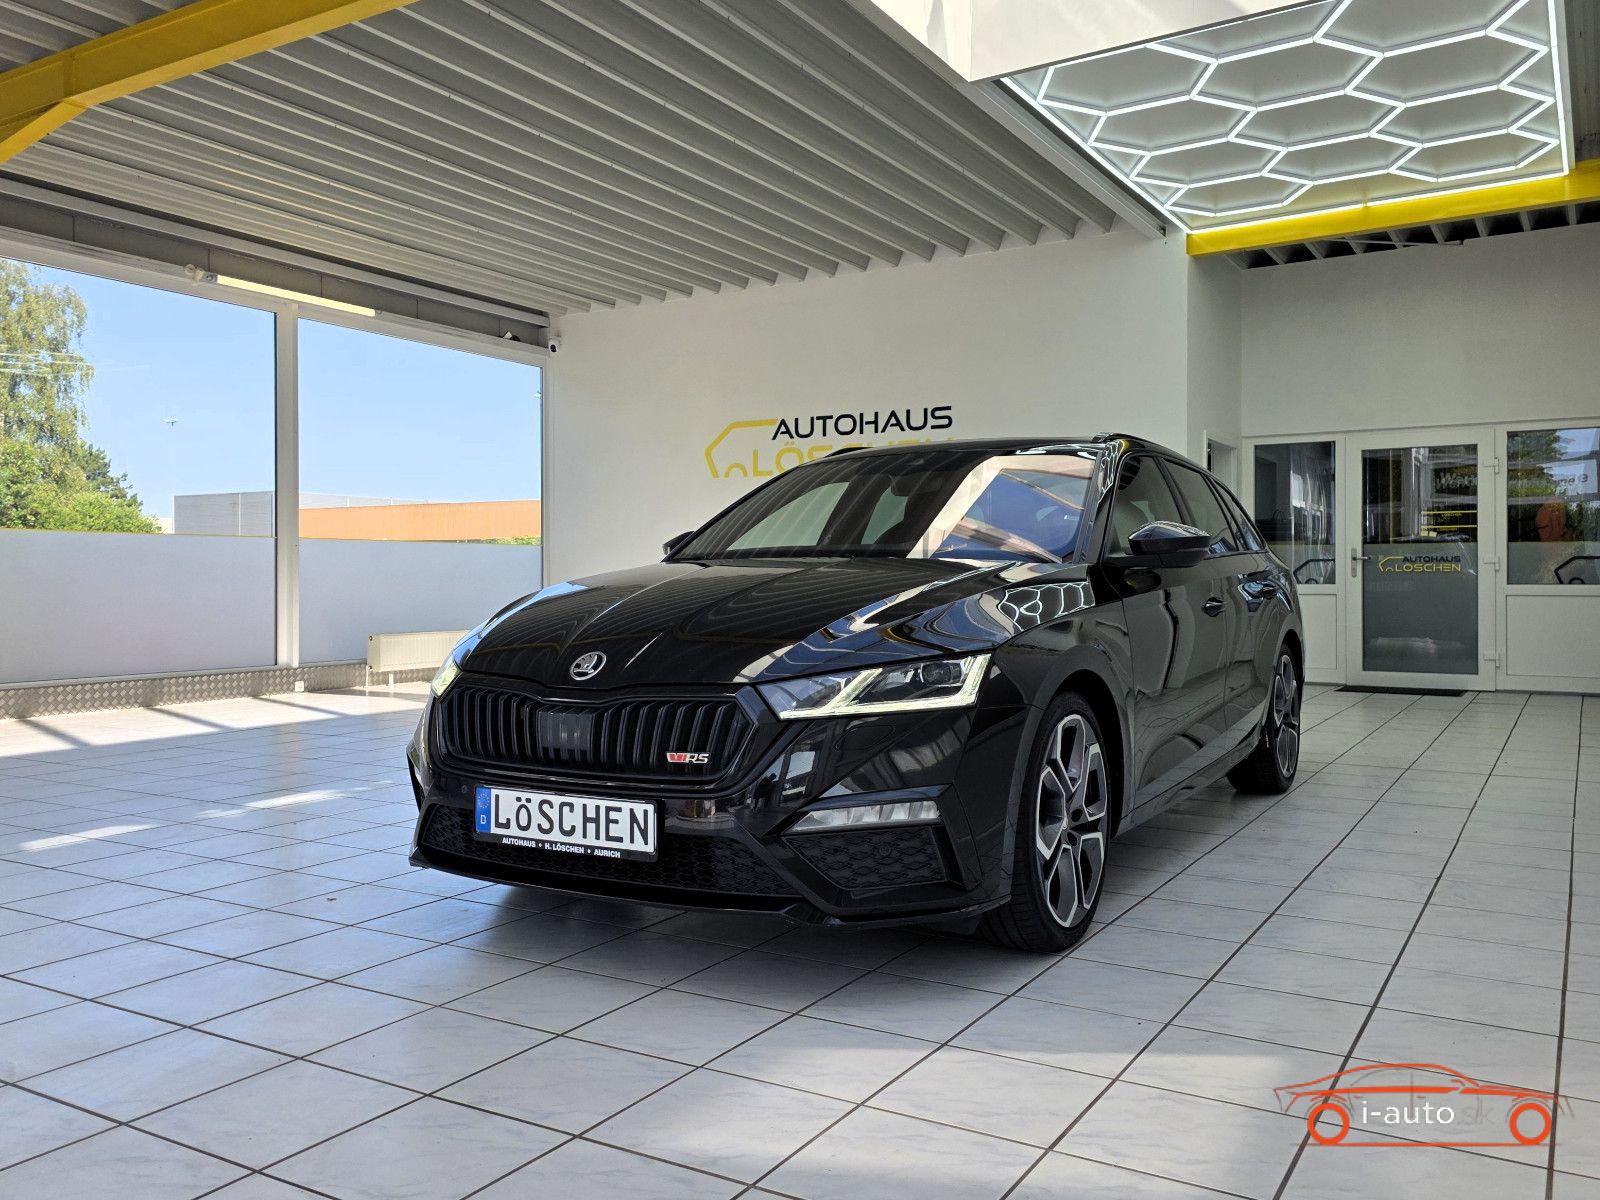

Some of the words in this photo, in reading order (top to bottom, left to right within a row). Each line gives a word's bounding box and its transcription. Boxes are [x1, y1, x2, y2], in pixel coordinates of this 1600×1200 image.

[771, 405, 953, 441] AUTOHAUS
[1402, 555, 1461, 563] AUTOHAUS
[501, 836, 537, 848] AUTOHAUS
[593, 848, 621, 859] AURICH
